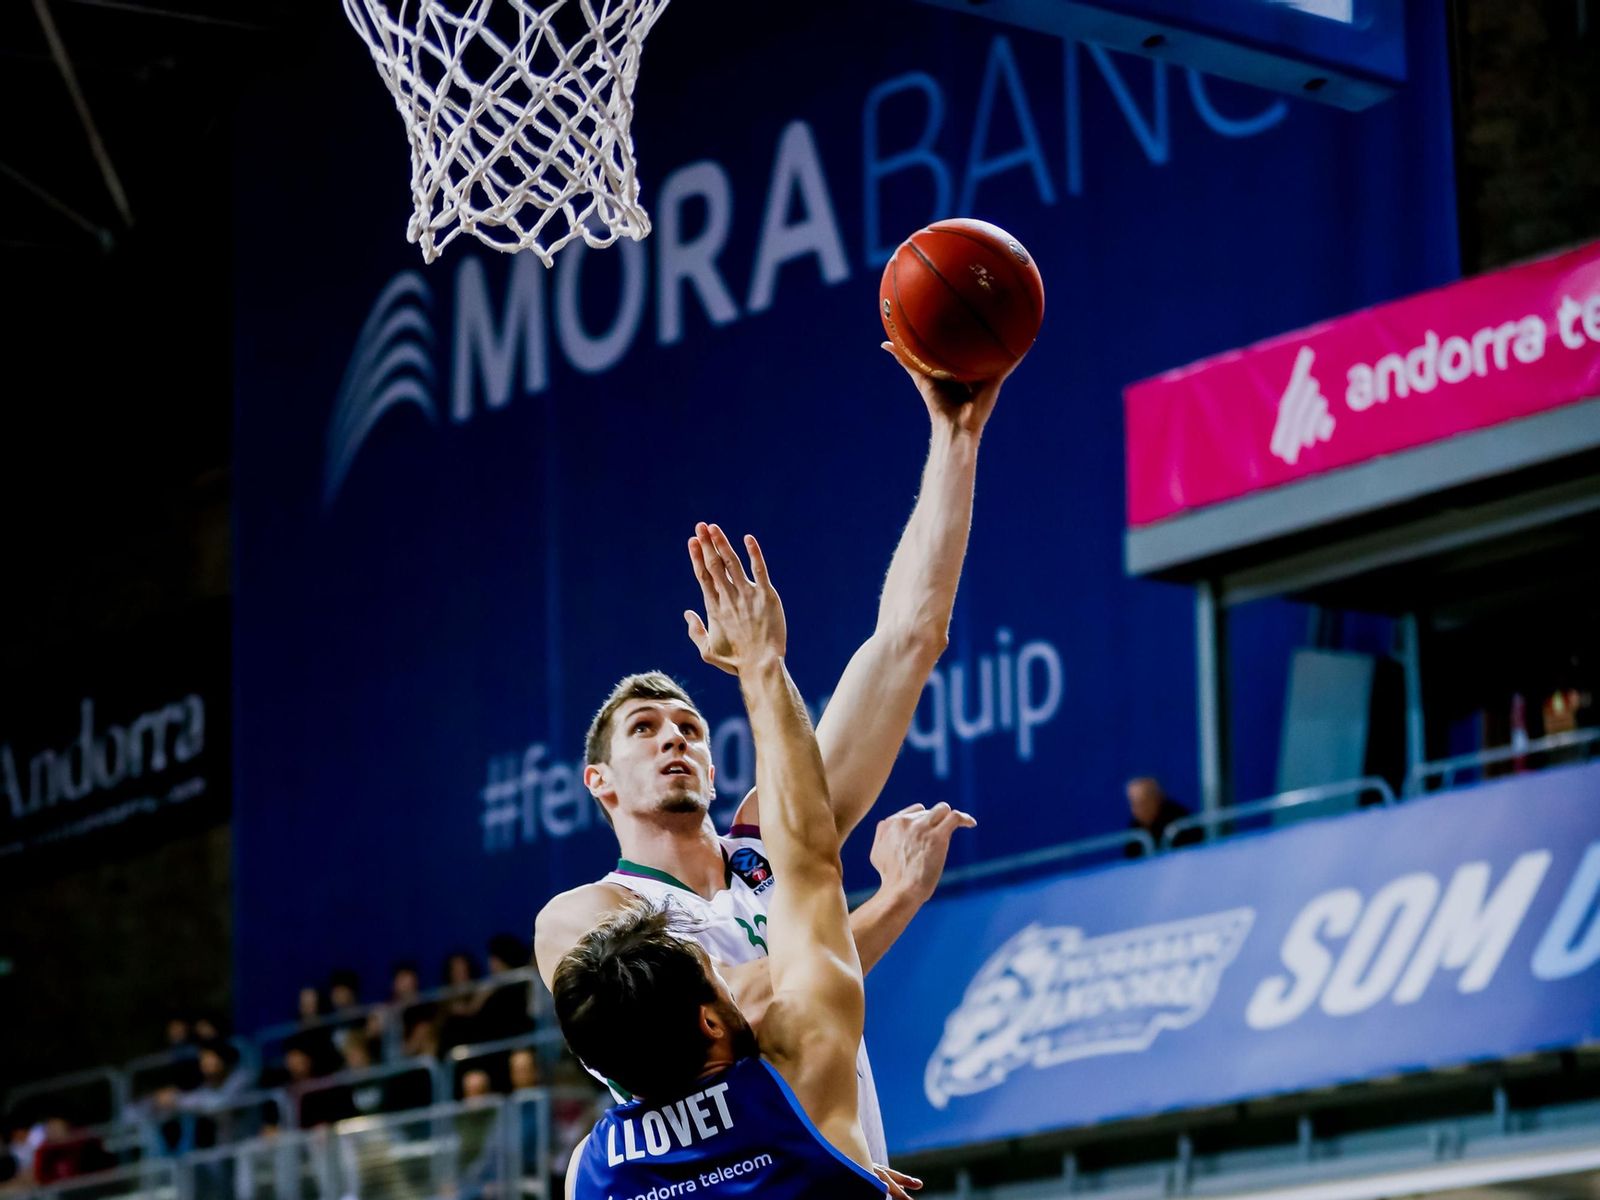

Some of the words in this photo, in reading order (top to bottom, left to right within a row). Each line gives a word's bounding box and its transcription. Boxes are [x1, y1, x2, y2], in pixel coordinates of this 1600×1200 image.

[1345, 328, 1547, 412] andorra
[1244, 848, 1554, 1031] SOM
[606, 1082, 735, 1168] LLOVET
[699, 1153, 773, 1188] telecom
